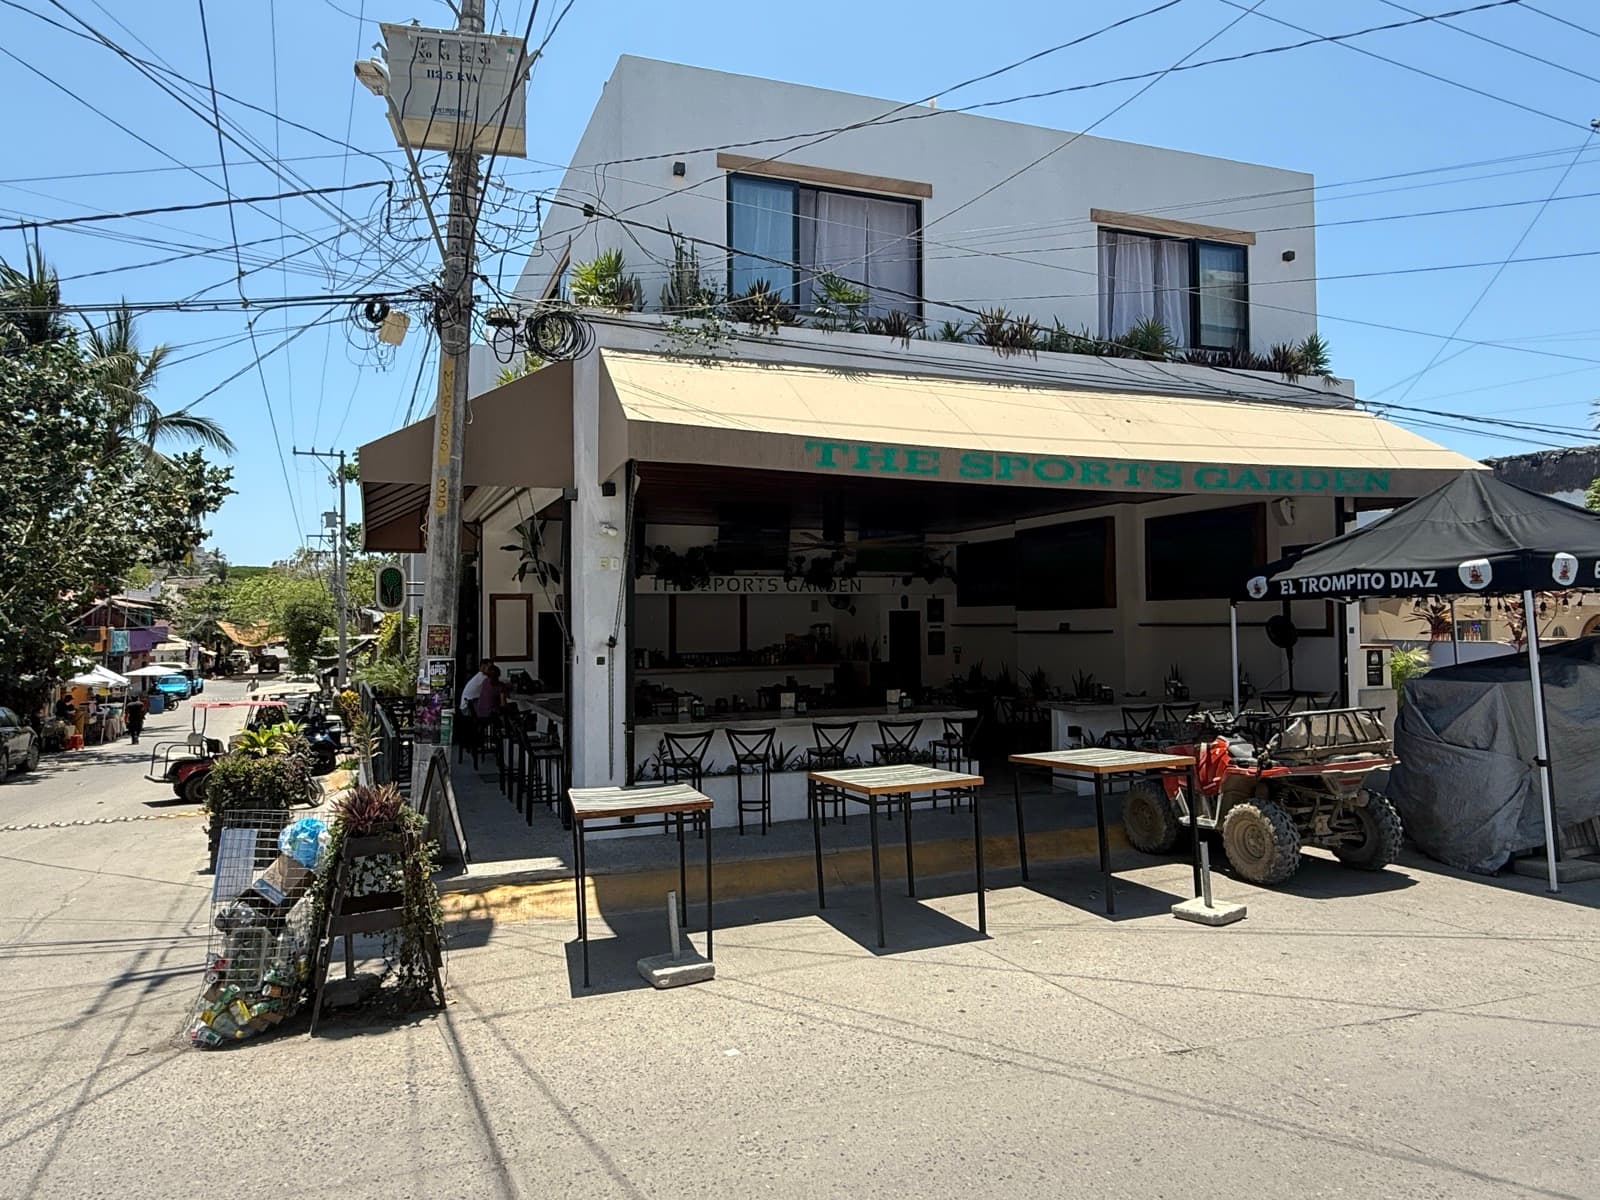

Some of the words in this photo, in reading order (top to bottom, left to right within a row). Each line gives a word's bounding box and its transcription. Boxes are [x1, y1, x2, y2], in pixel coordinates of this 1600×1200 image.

[804, 441, 940, 476] THE
[959, 453, 1183, 489] SPORTS
[1193, 466, 1391, 492] GARDEN
[651, 576, 689, 592] TH
[1280, 580, 1296, 595] EL
[1300, 573, 1386, 592] TROMPITO
[1391, 570, 1438, 588] DIAZ
